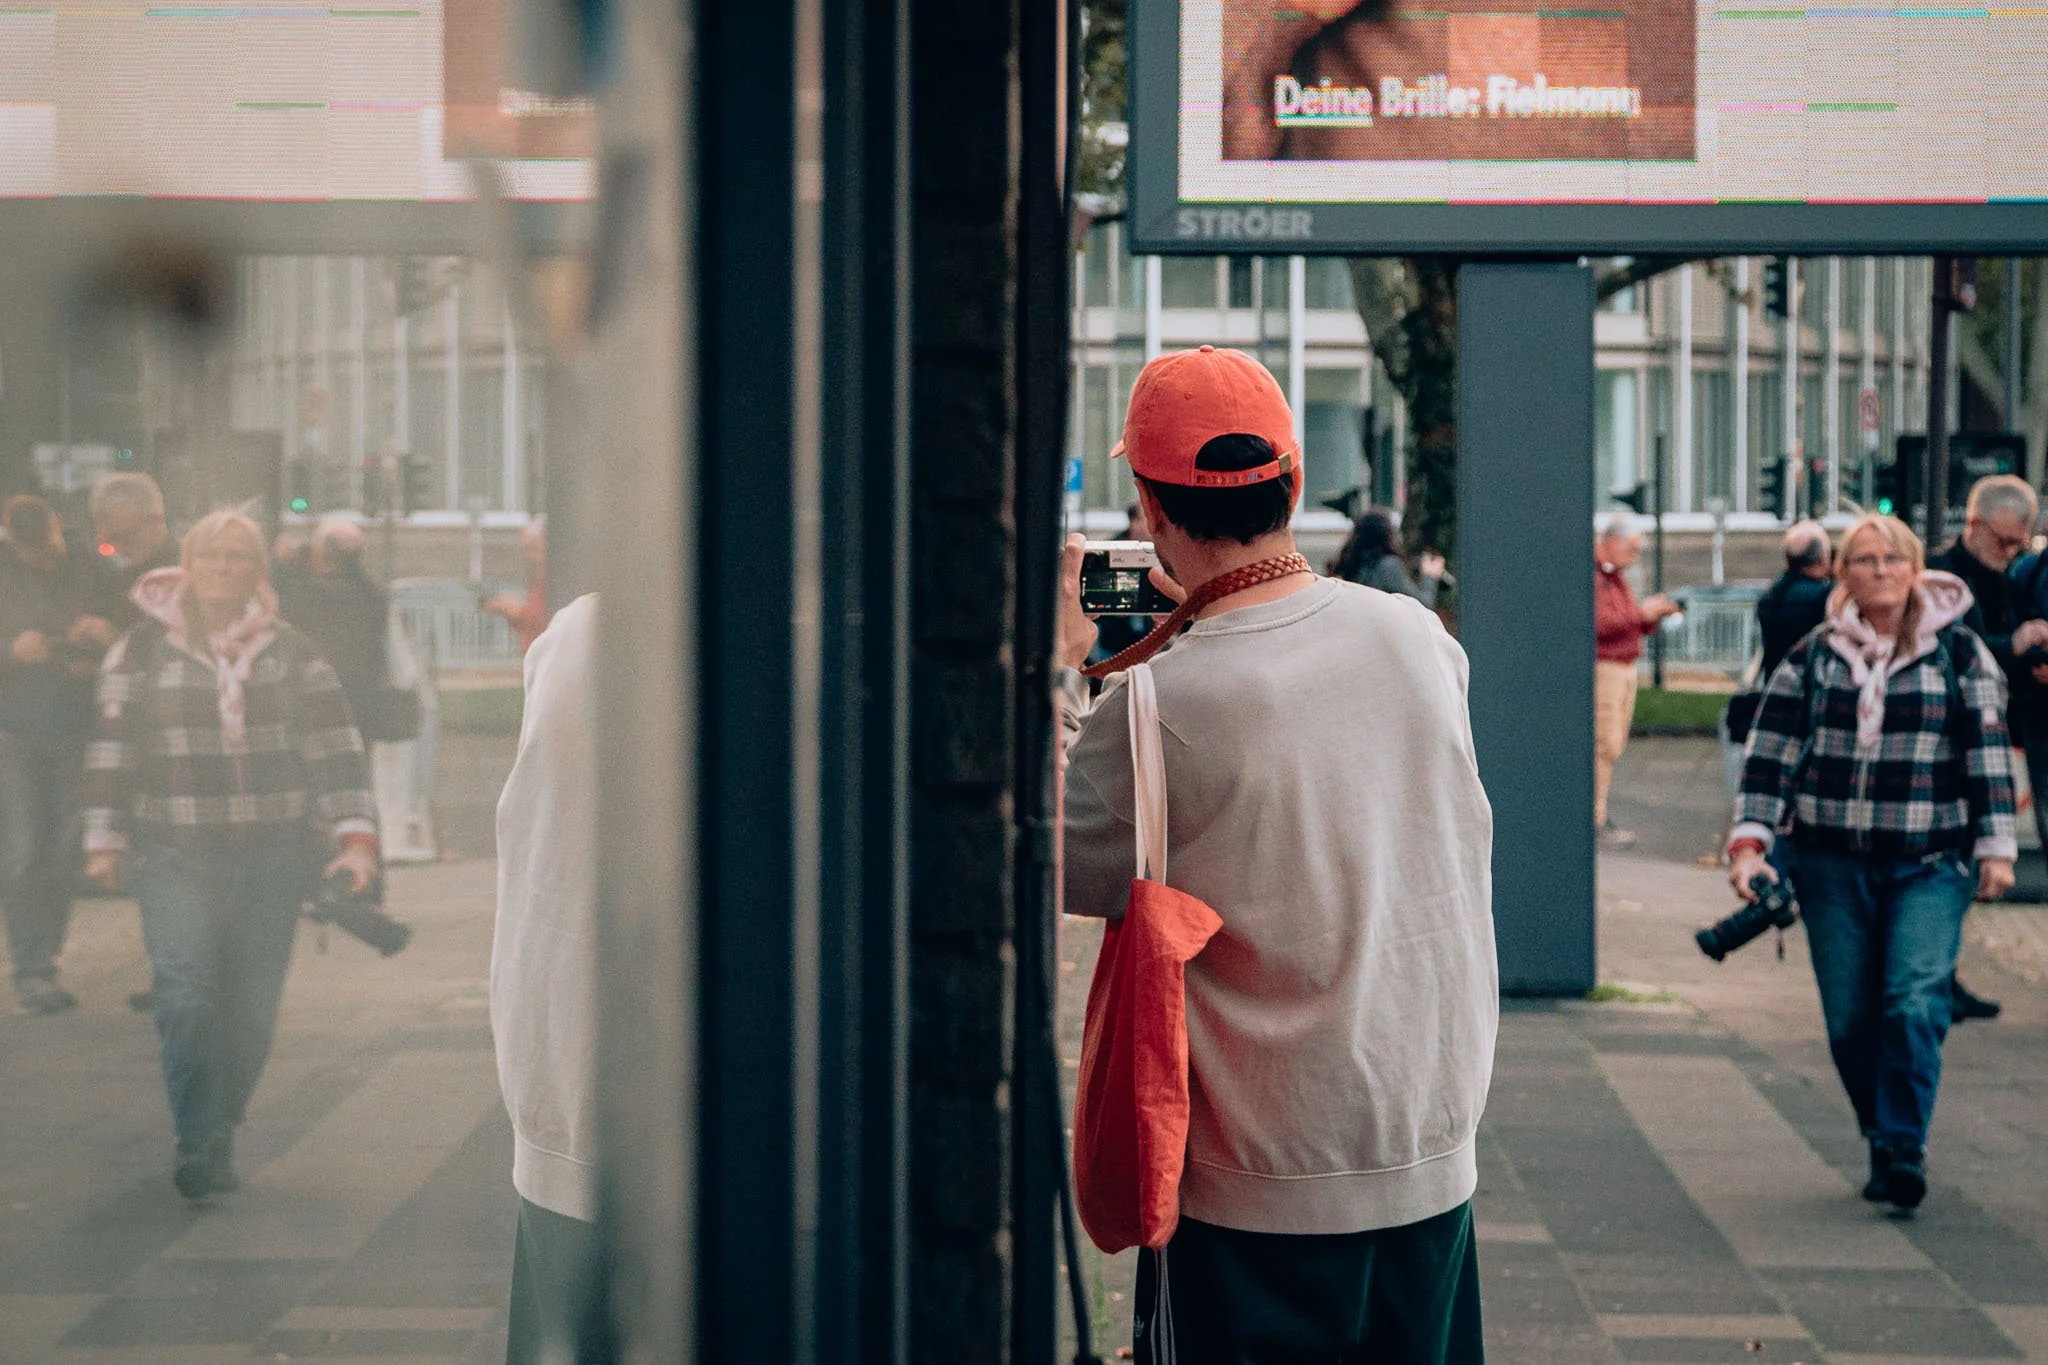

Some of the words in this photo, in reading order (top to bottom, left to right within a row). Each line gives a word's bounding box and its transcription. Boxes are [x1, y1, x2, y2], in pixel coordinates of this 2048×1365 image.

[1274, 75, 1373, 116] Deine
[1380, 73, 1479, 118] Brille:
[1487, 72, 1641, 118] Fielmann
